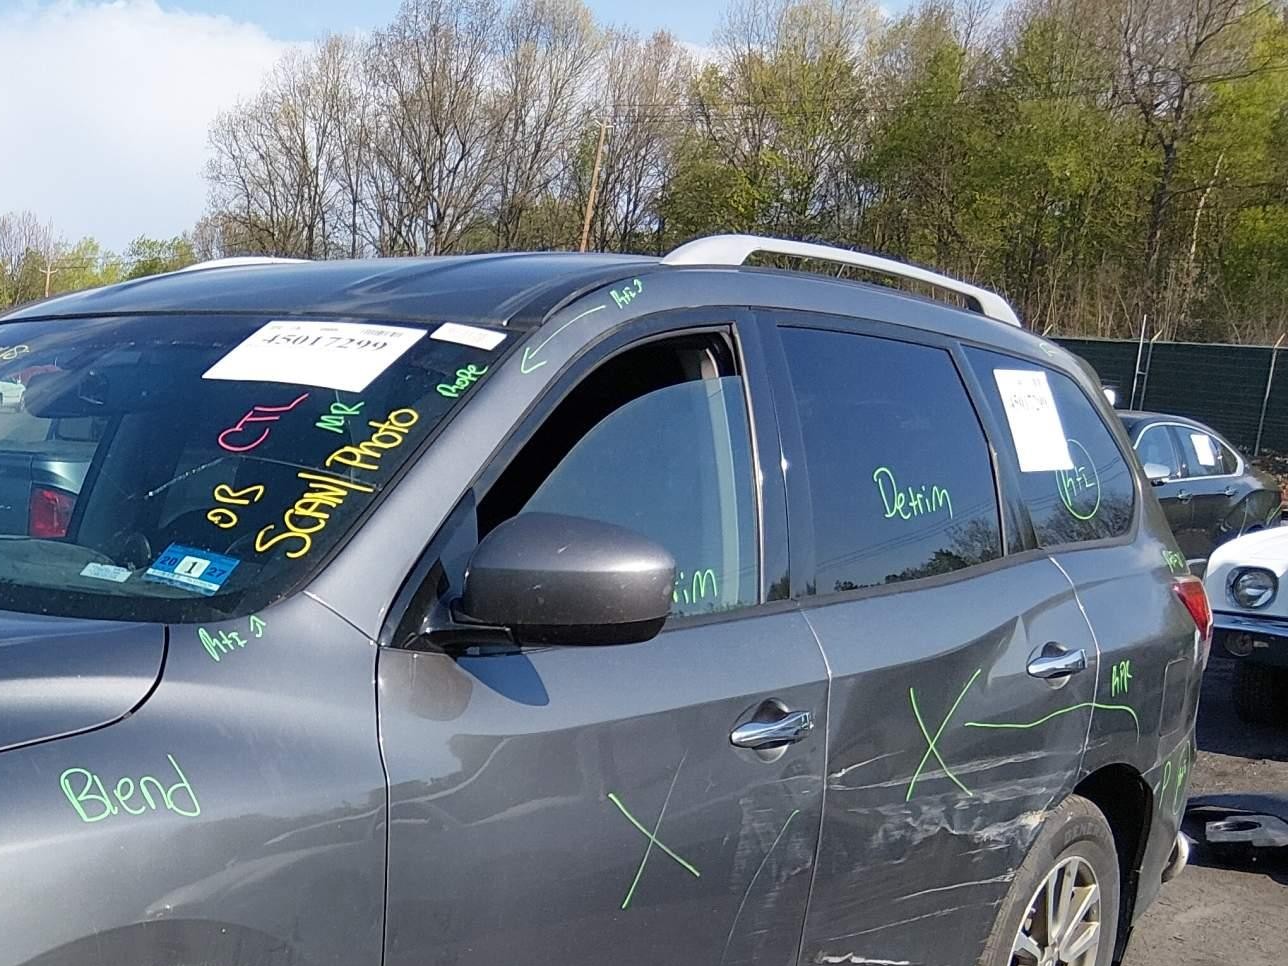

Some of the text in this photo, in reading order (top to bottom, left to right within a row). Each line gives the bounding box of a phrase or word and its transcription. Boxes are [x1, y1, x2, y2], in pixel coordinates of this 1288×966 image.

[260, 333, 389, 352] 45017299
[873, 466, 954, 520] Detrim
[159, 555, 176, 567] 20
[187, 561, 199, 574] 1
[207, 566, 226, 579] 27
[60, 753, 201, 822] Blend
